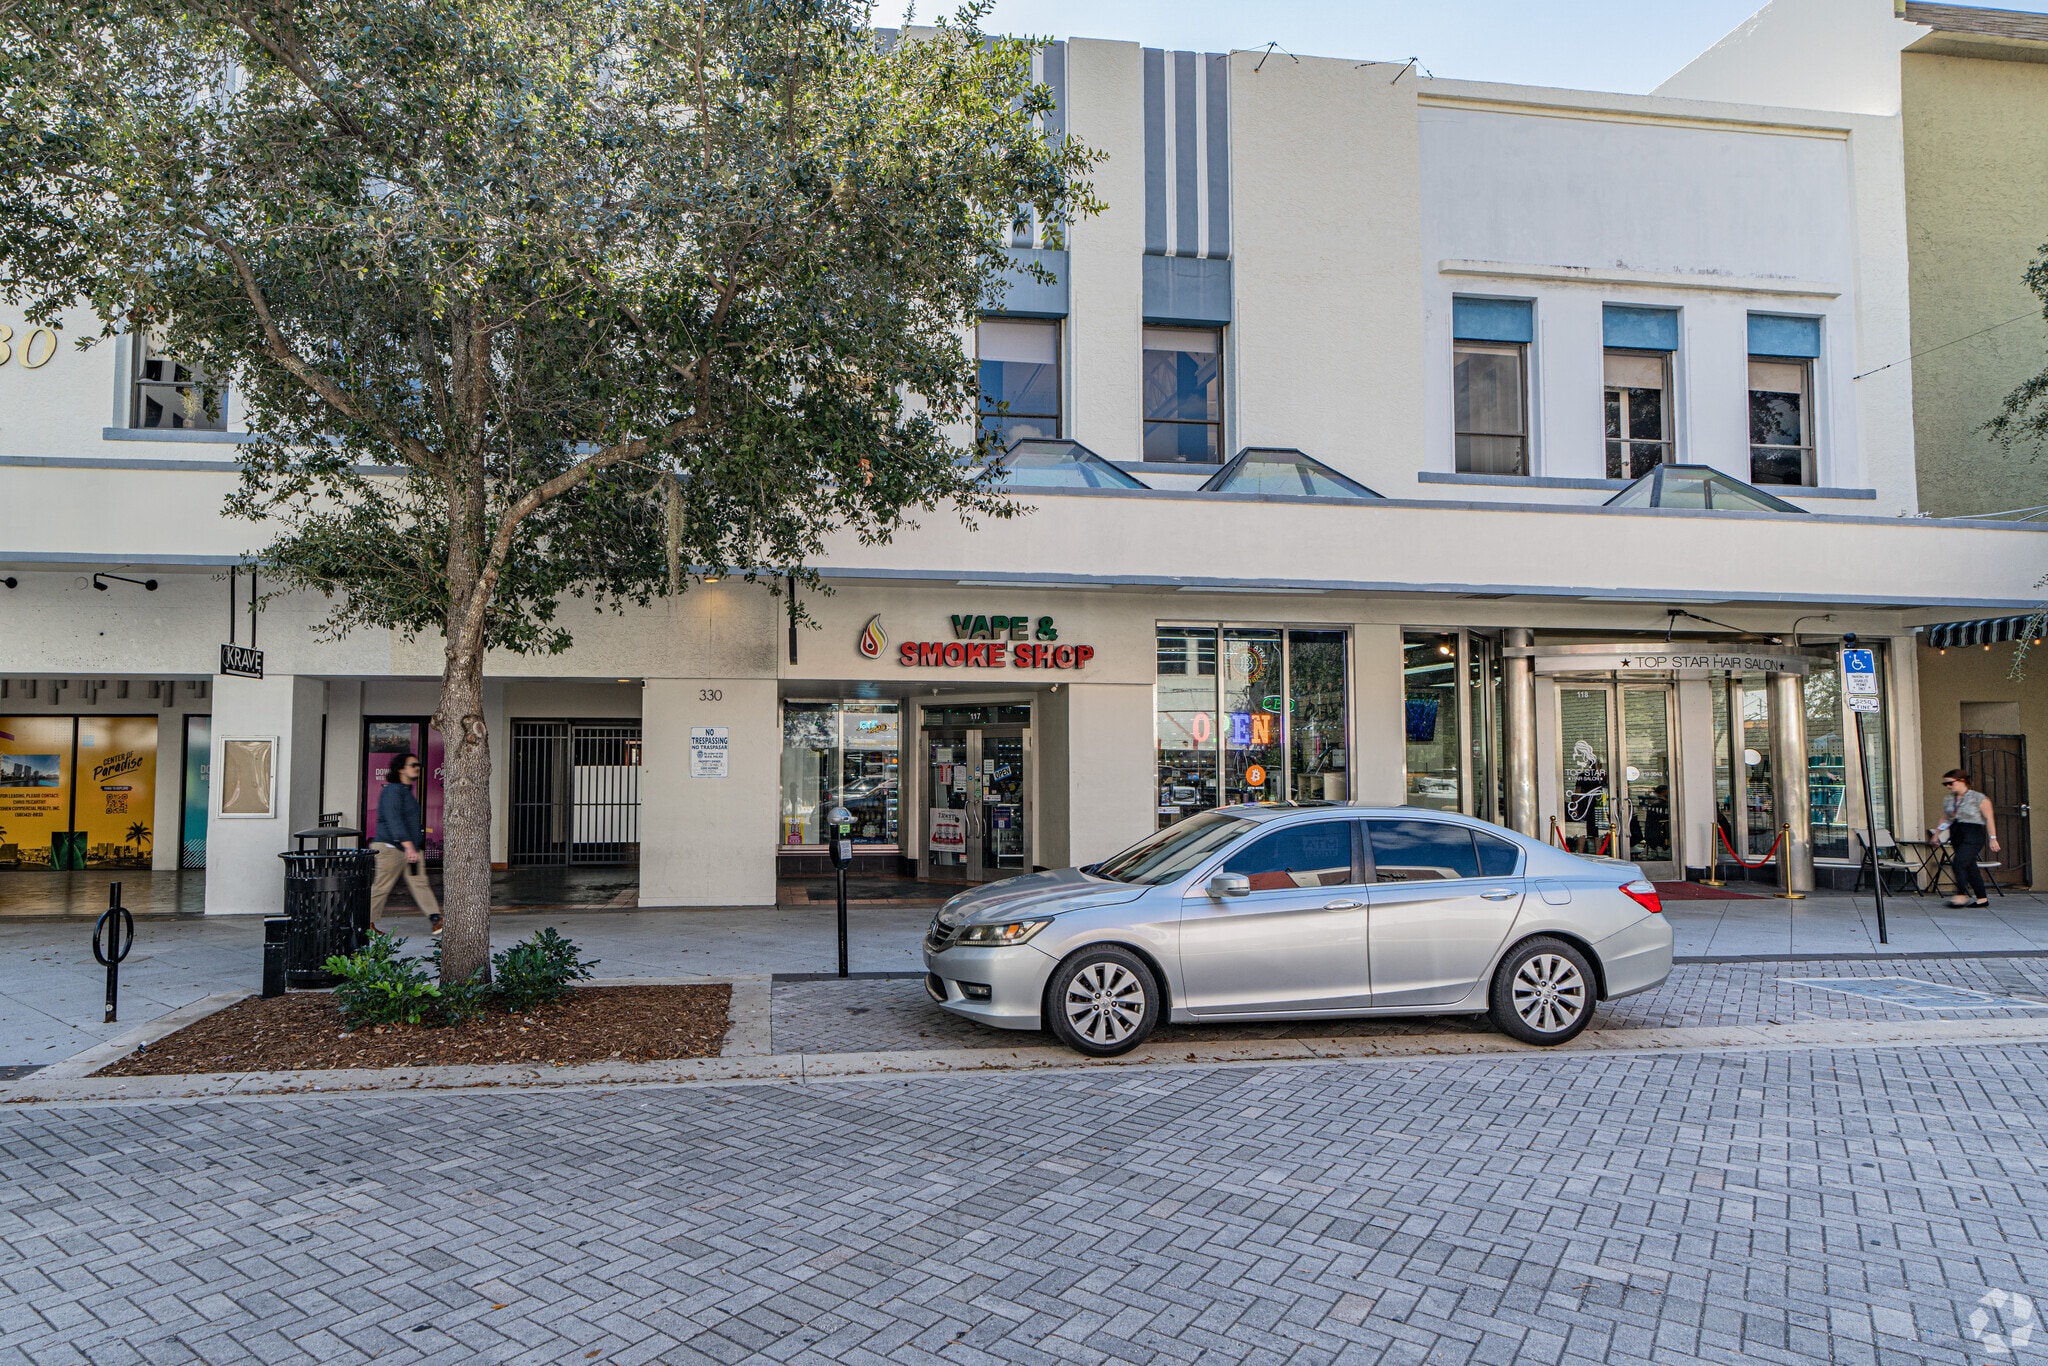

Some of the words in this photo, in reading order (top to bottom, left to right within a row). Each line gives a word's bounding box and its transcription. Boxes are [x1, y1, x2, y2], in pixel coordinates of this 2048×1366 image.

[951, 614, 1029, 641] VAPE
[1036, 616, 1058, 641] &
[226, 646, 262, 670] KRAVE
[900, 641, 1007, 668] SMOKE
[1014, 643, 1095, 670] SHOP
[1635, 656, 1667, 668] TOP
[1672, 656, 1709, 668] STAR
[1713, 656, 1741, 669] HAIR
[1744, 657, 1778, 671] SALON
[699, 689, 723, 702] 330
[705, 728, 714, 736] NO
[1192, 713, 1272, 744] OPEN
[691, 737, 728, 745] TRESPASSING
[103, 753, 125, 766] CENTER
[126, 751, 134, 759] OF
[93, 756, 143, 781] Paradise
[994, 768, 1011, 779] OPEN
